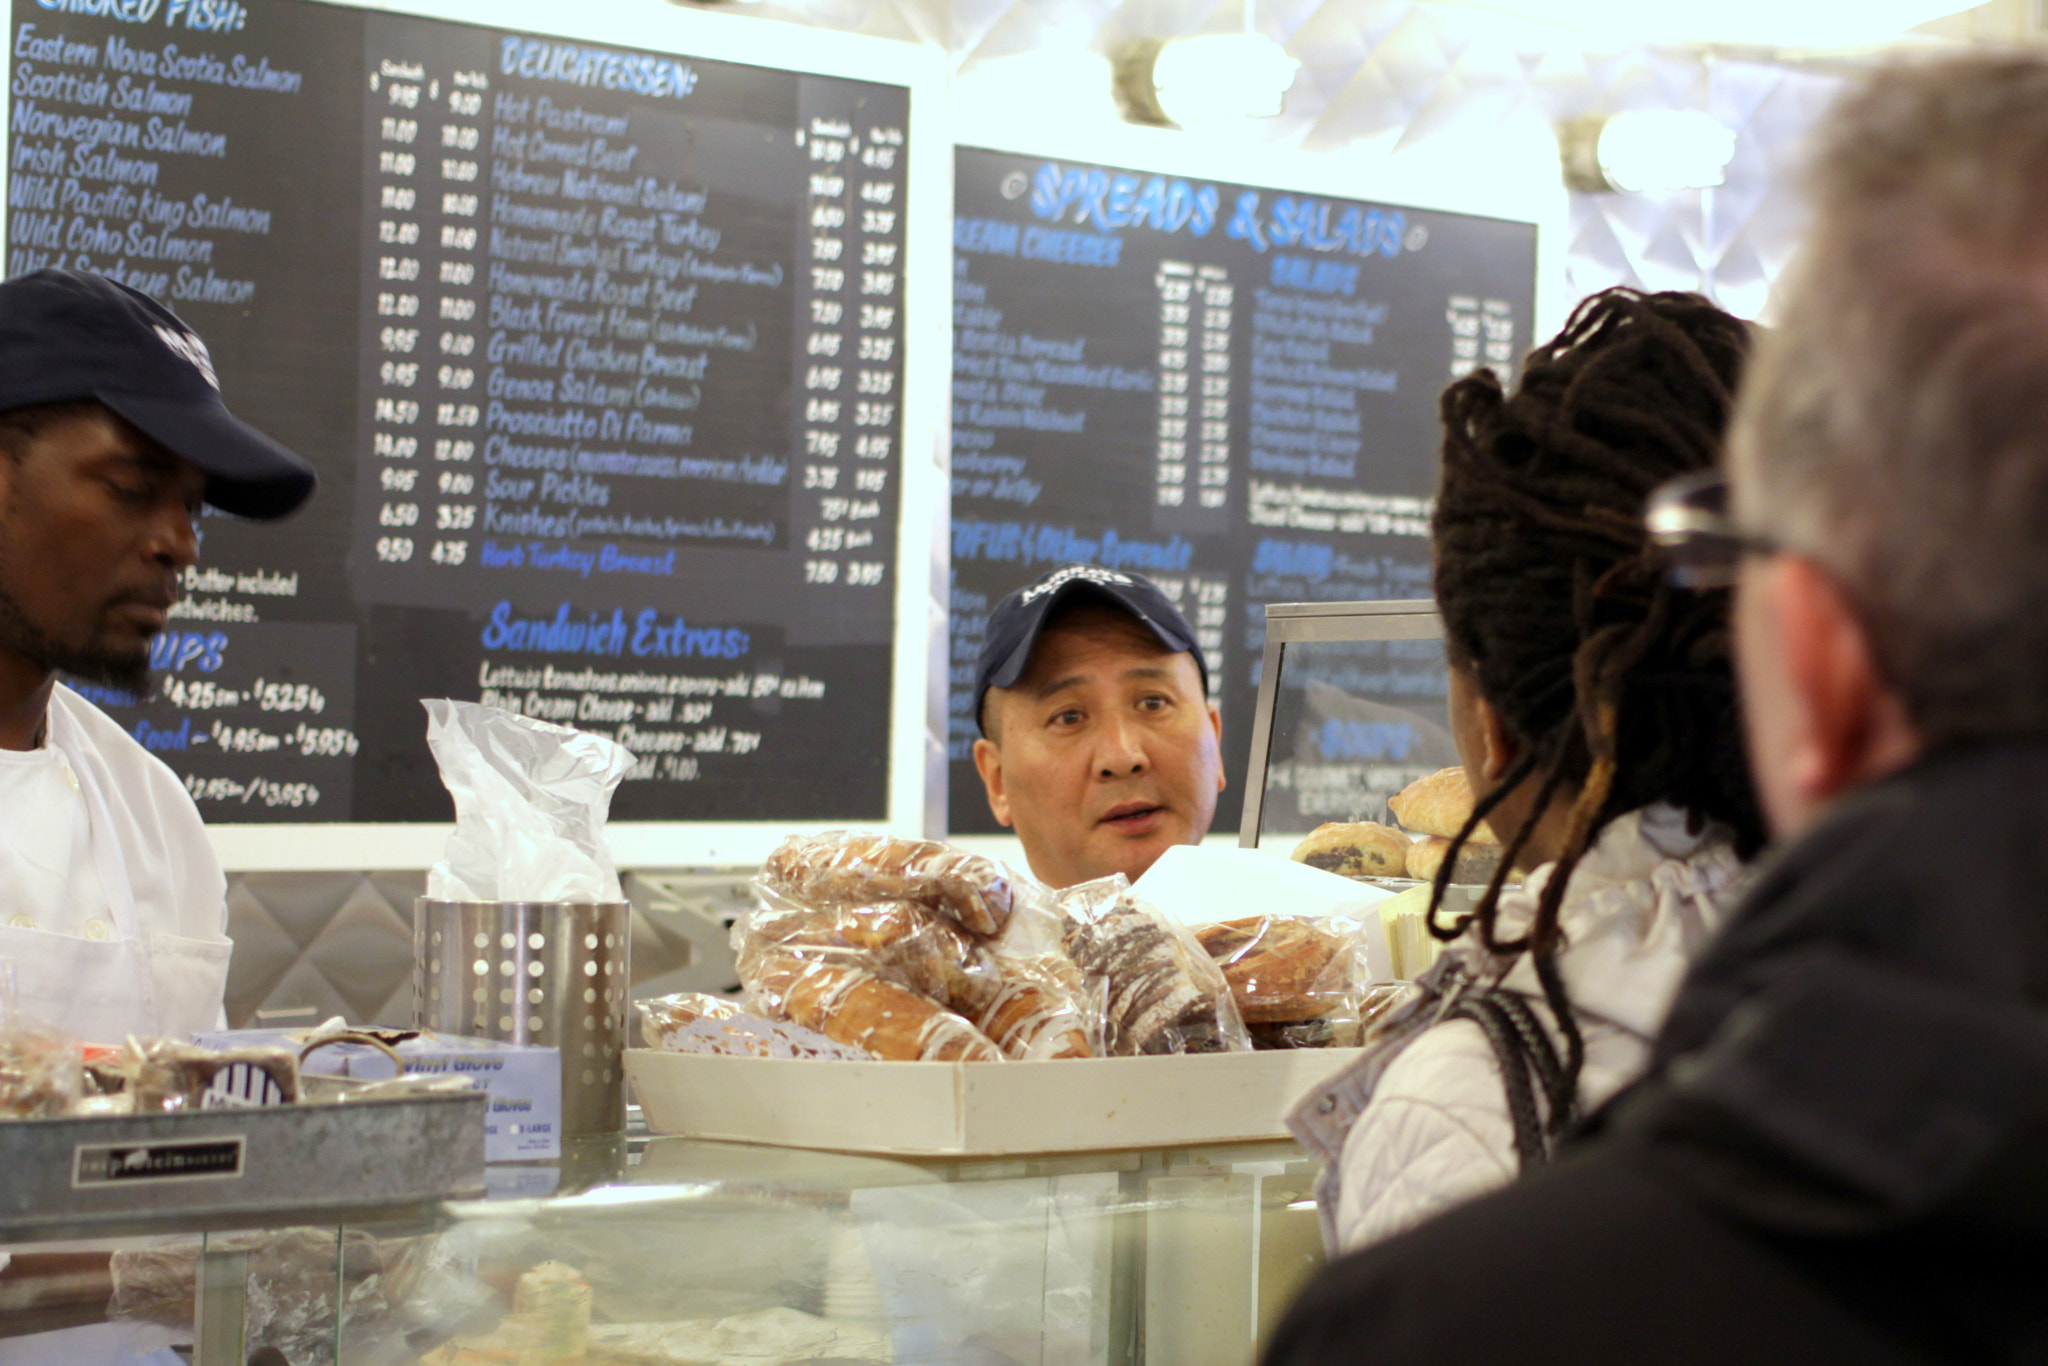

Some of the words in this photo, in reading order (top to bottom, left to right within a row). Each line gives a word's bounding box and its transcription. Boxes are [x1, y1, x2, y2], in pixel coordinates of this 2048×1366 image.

[14, 23, 98, 66] Eastern
[104, 35, 157, 75] Nova
[159, 44, 225, 84] Scotia
[227, 54, 302, 93] Salmon
[12, 62, 109, 107] Scottish
[111, 75, 193, 117] Salmon
[11, 99, 140, 149] Norwegian
[143, 116, 226, 157] Salmon
[493, 91, 531, 124] Hot
[534, 96, 630, 136] Pastrami
[12, 136, 66, 176] Irish
[69, 141, 159, 186] Salmon
[490, 125, 527, 159] Hot
[10, 172, 59, 210] Wild
[60, 178, 137, 219] Pacific
[139, 188, 187, 232] King
[188, 193, 271, 234] Salmon
[561, 169, 643, 207] National
[641, 177, 709, 214] Salami
[1031, 161, 1220, 237] SPREADS
[1270, 194, 1405, 258] SALADS
[10, 212, 64, 249] Wild
[66, 215, 123, 255] Coho
[125, 221, 214, 264] Salmon
[490, 192, 597, 237] Homemade
[599, 205, 657, 242] Roast
[658, 213, 721, 254] Turkey
[489, 226, 558, 264] Natural
[621, 241, 682, 281] Turkey
[171, 265, 255, 303] Salmon
[488, 261, 590, 302] Homemade
[591, 270, 650, 308] Roast
[488, 295, 542, 333] Black
[546, 300, 604, 337] Forest
[487, 330, 564, 367] Grilled
[565, 337, 639, 373] Chicken
[640, 343, 709, 381] Breast
[487, 366, 555, 402] Genoa
[559, 371, 633, 408] Salami
[486, 400, 598, 439] Prosciutto
[601, 409, 626, 441] Di
[626, 411, 693, 446] Parma
[484, 434, 569, 471] Cheeses
[484, 468, 536, 501] Sour
[539, 471, 611, 507] Pickles
[483, 502, 569, 538] Knishes
[184, 564, 235, 593] Butter
[236, 567, 298, 597] included
[527, 542, 596, 579] Turkey
[600, 543, 676, 576] Breast
[167, 593, 259, 622] ndwiches.
[482, 599, 628, 660] Sandwich
[630, 608, 750, 659] Extras:
[150, 631, 228, 673] UPS
[524, 691, 577, 720] Cream
